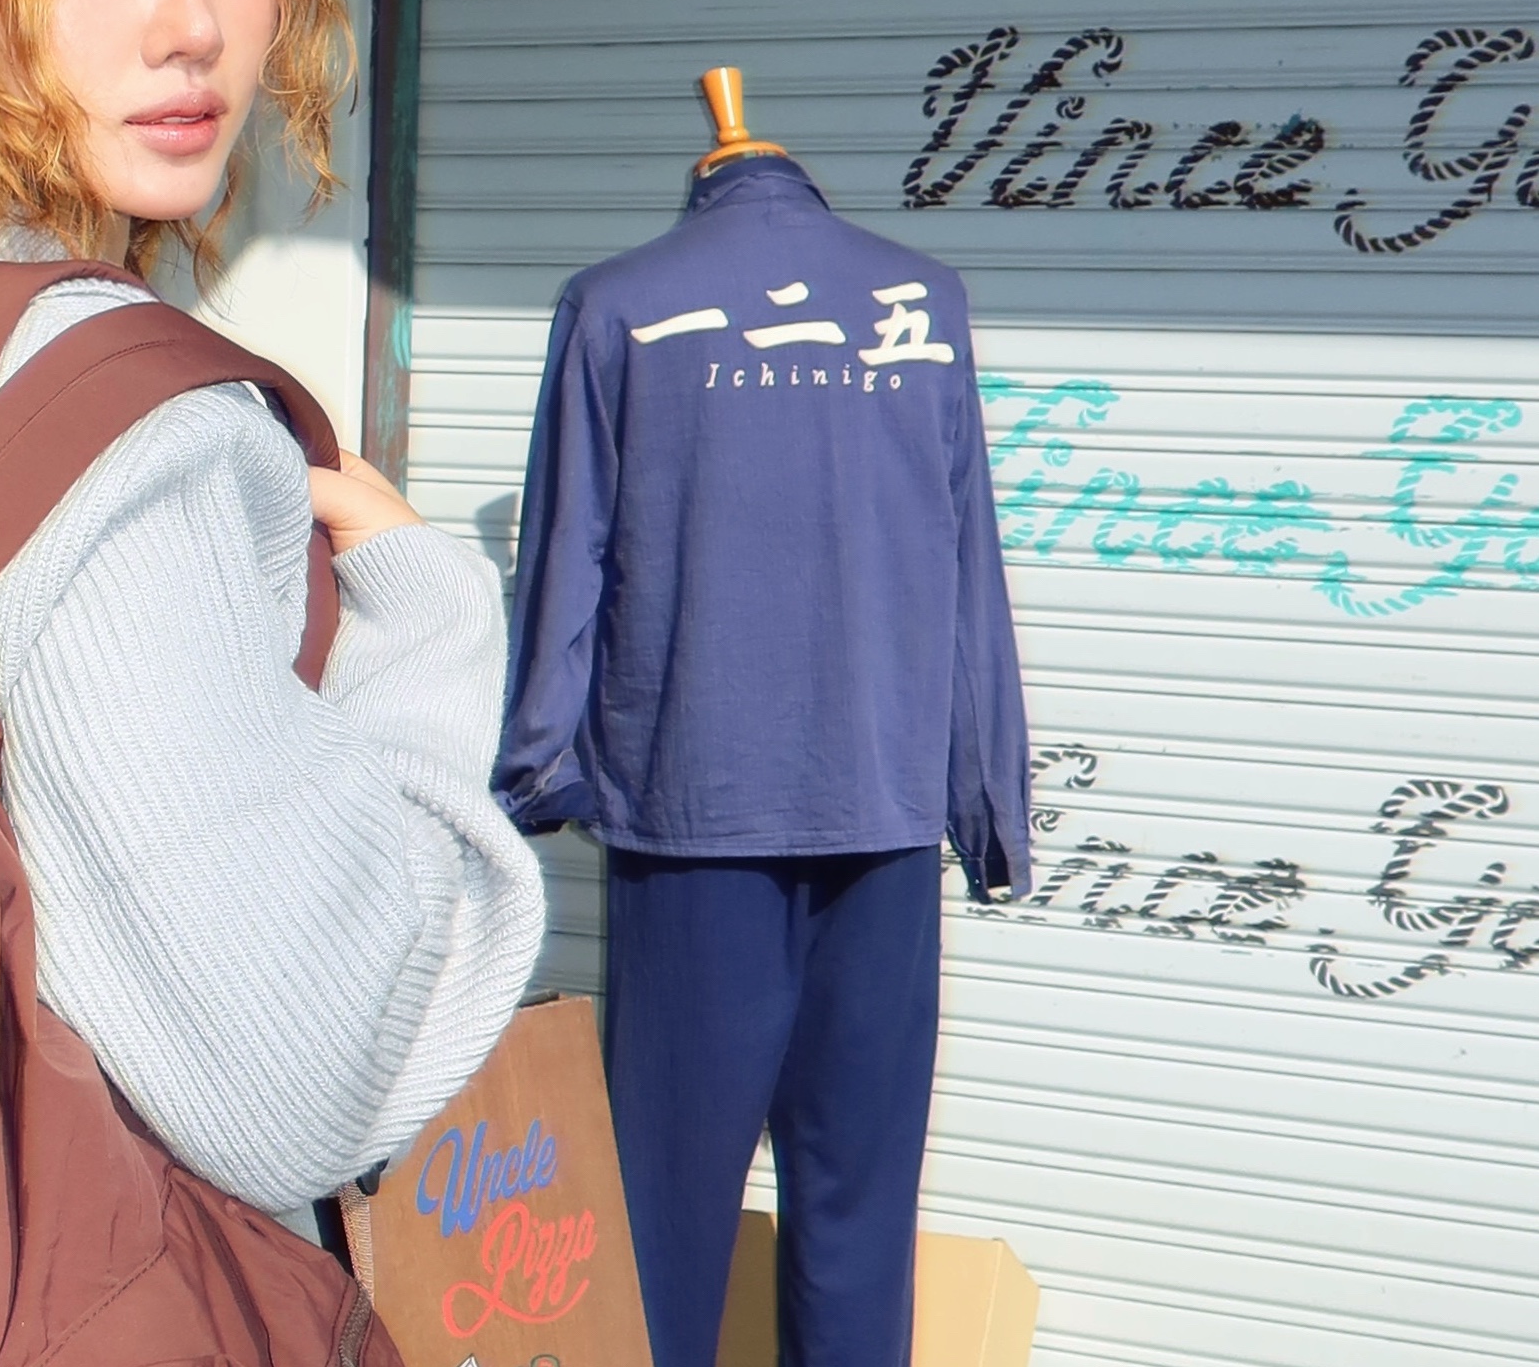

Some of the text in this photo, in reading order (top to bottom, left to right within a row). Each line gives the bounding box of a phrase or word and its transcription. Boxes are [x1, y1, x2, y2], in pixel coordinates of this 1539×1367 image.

[902, 27, 1539, 254] Vince G
[630, 280, 957, 366] 一二五
[705, 362, 903, 393] Ichinigo
[416, 1118, 557, 1238] Uncle
[443, 1201, 597, 1339] Pizza
